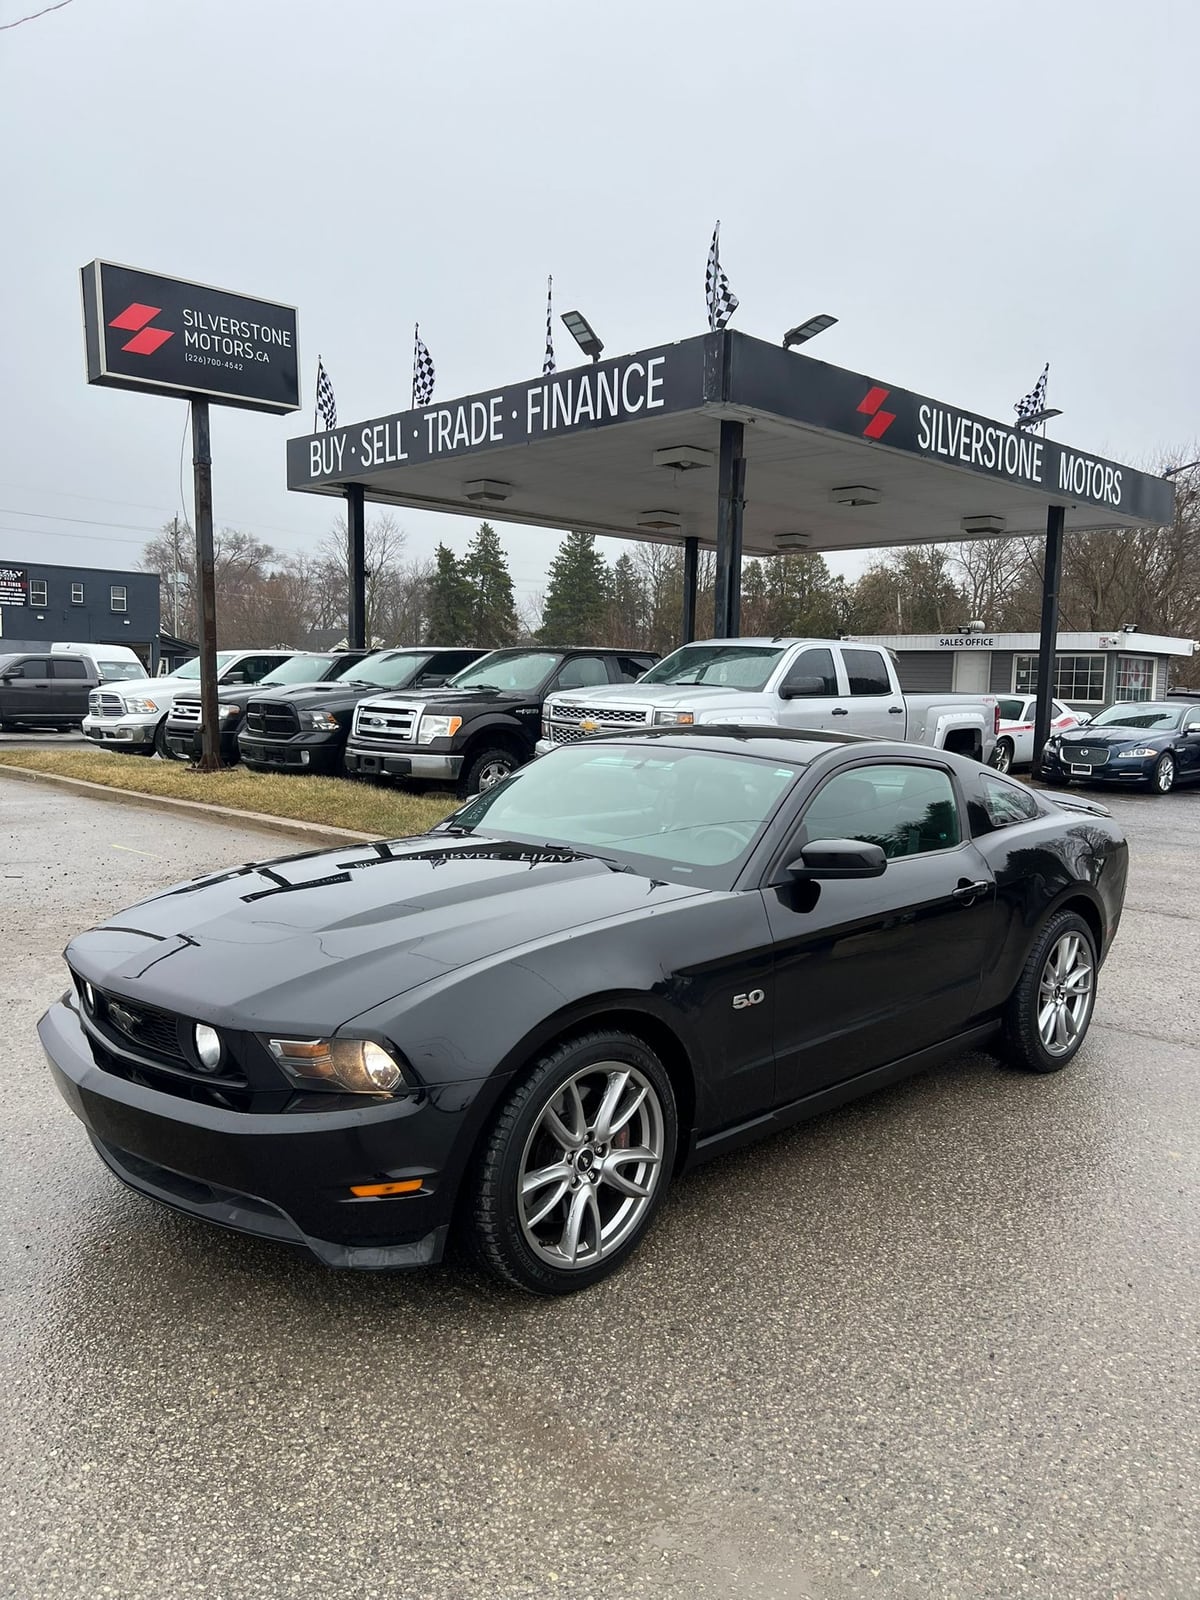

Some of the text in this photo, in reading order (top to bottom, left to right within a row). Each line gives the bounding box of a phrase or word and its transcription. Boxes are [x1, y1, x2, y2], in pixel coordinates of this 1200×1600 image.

[183, 309, 292, 348] SILVERSTONE
[184, 330, 270, 363] MOTORS.CA
[185, 353, 244, 371] (226)700-4542
[309, 356, 666, 478] BUY SELL TRADE FINANCE
[917, 404, 1122, 506] SILVERSTONE MOTORS
[939, 638, 994, 646] SALES OFFICE
[732, 988, 765, 1010] 5.0
